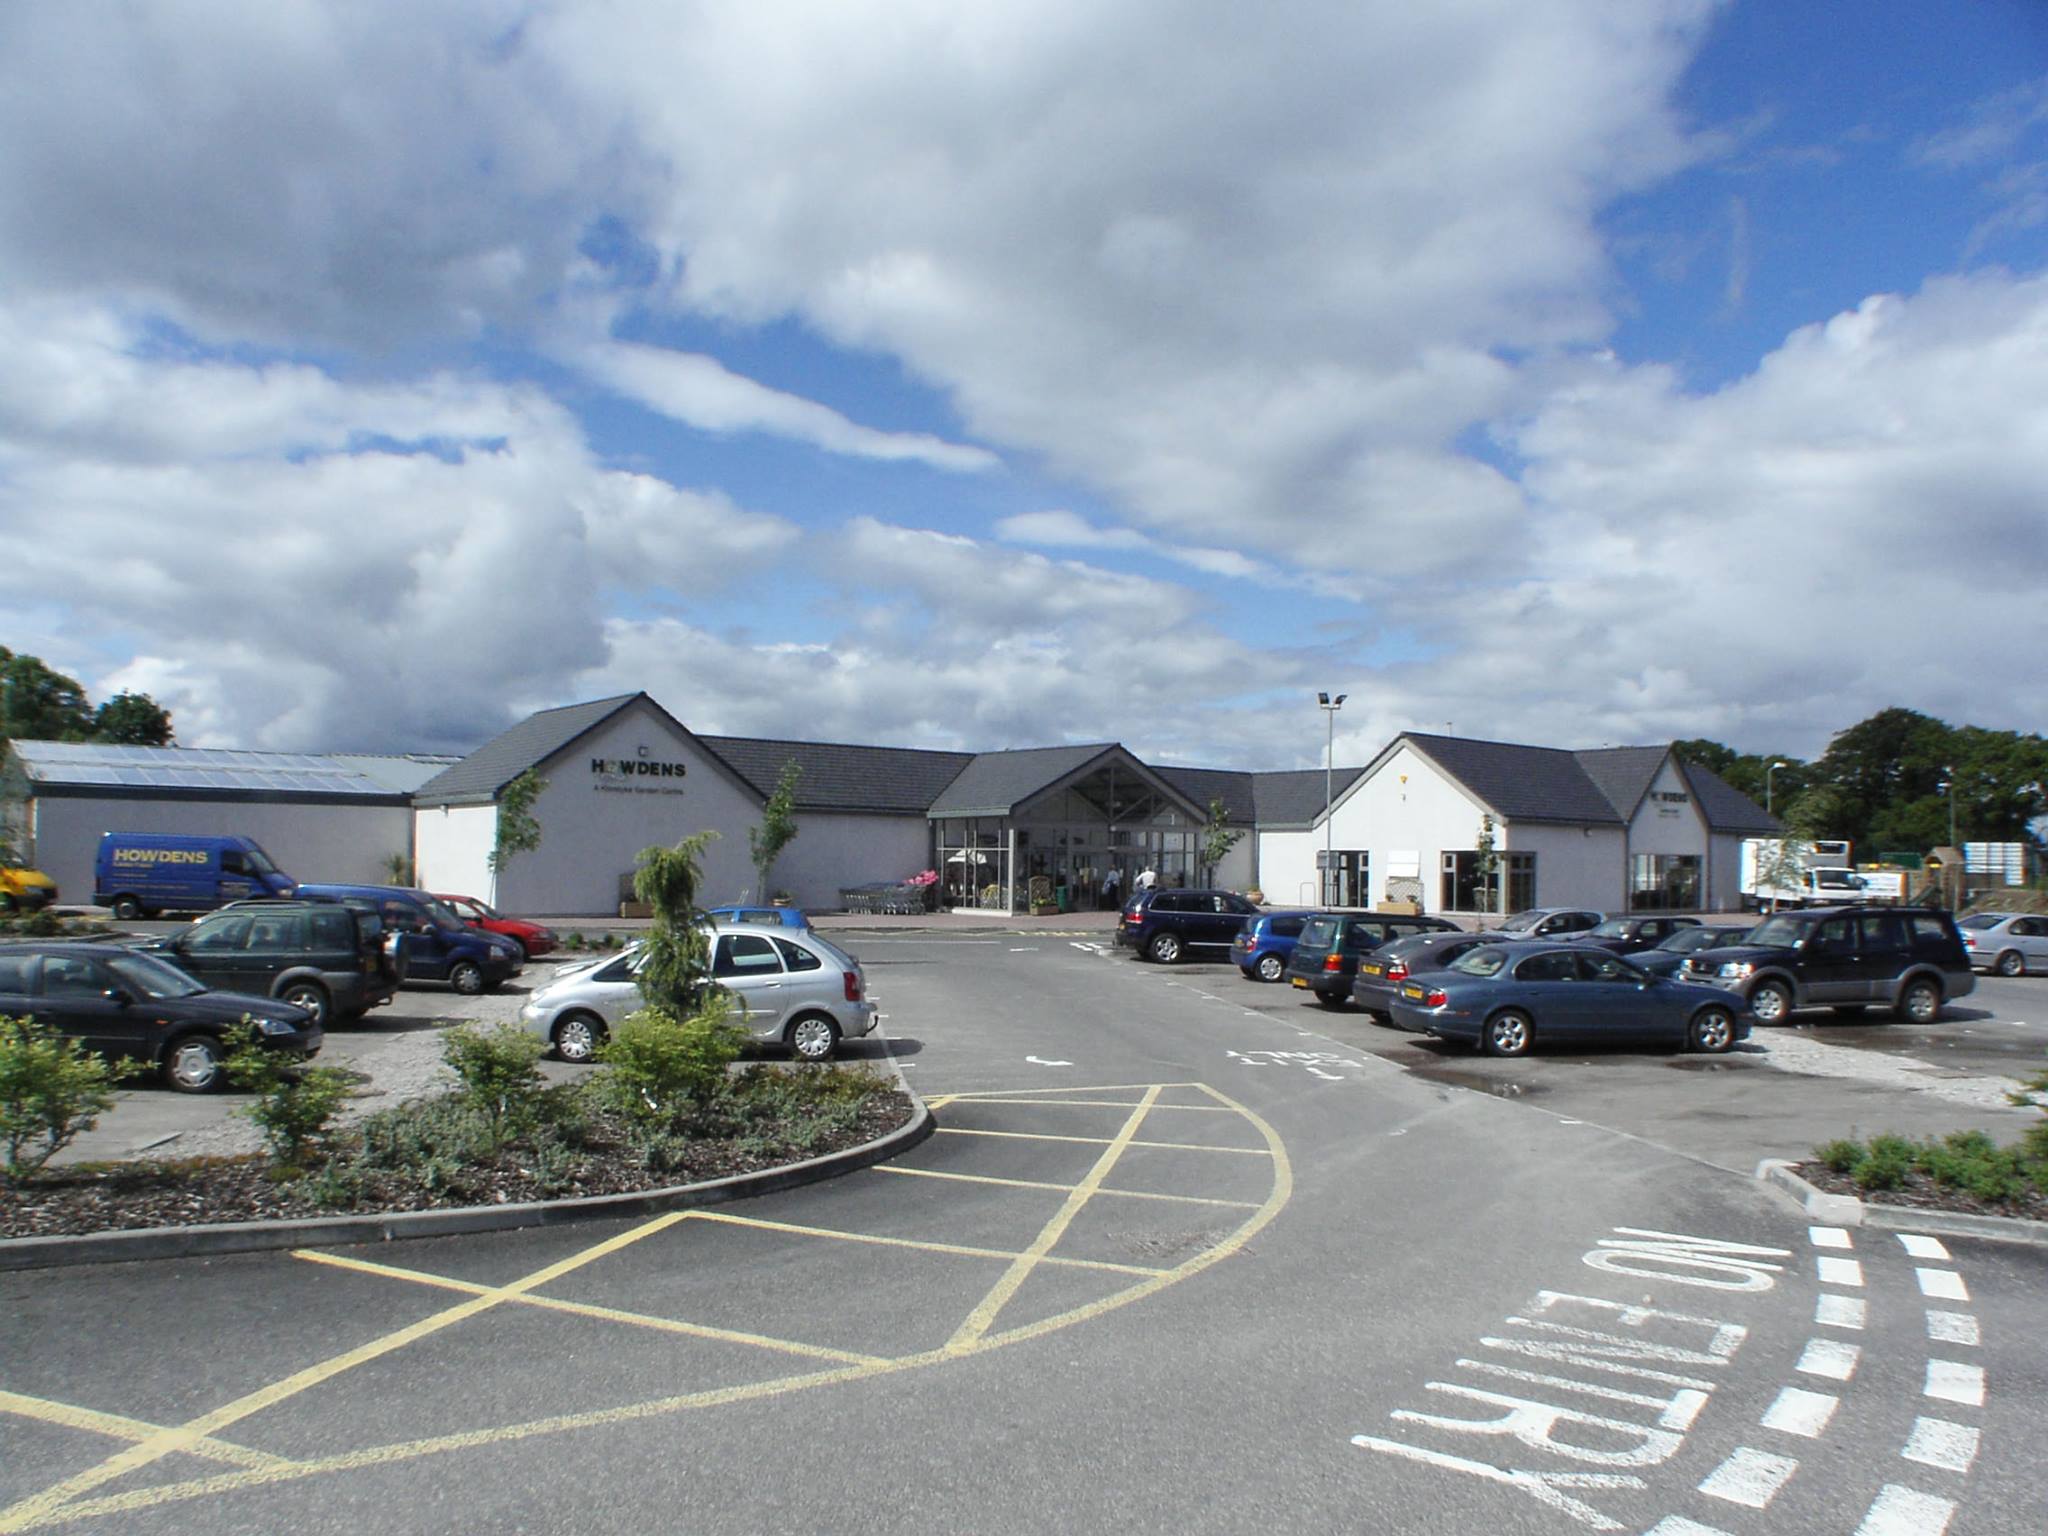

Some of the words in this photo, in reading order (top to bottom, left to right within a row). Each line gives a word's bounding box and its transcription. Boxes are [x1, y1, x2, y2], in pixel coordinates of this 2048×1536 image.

[592, 758, 687, 777] HOWDENS
[113, 849, 209, 864] HOWDENS
[1581, 1226, 1793, 1292] NO
[1350, 1289, 1749, 1531] ENTRY
